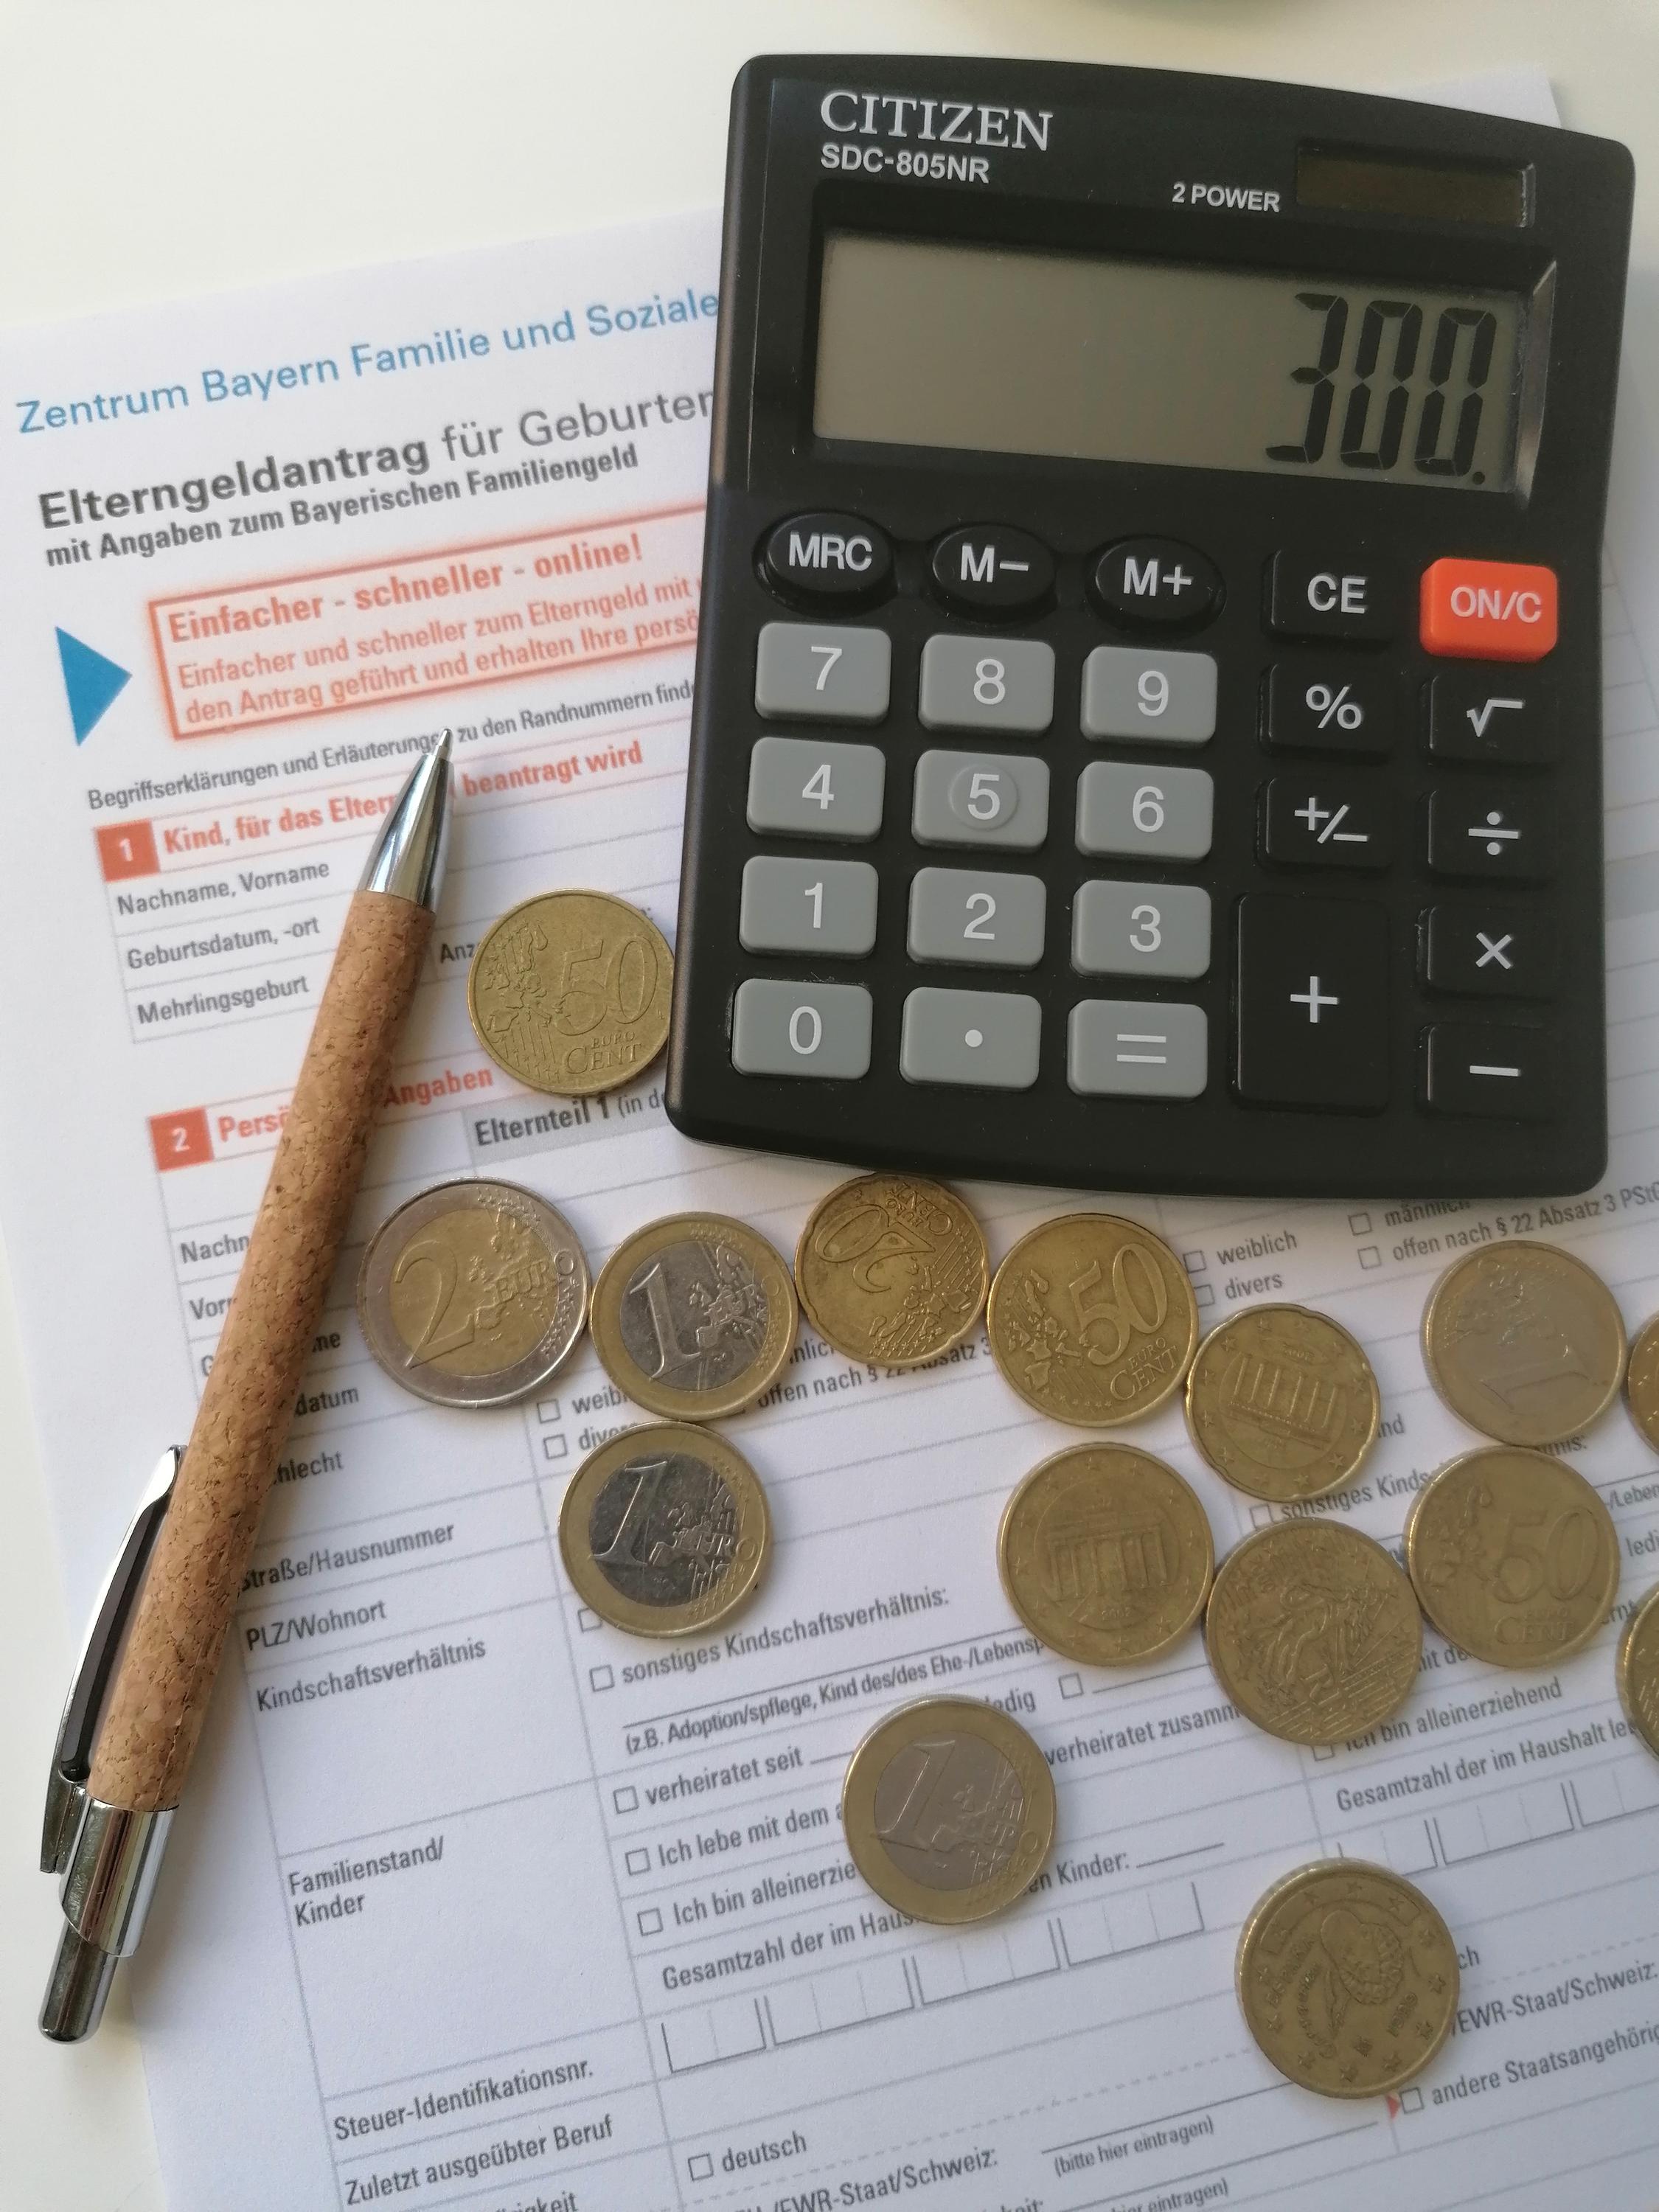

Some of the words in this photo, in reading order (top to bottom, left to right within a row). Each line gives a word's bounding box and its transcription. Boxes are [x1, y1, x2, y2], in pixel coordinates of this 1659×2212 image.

[820, 89, 1053, 152] CITIZEN
[821, 145, 990, 184] SDC-805NR
[1172, 184, 1186, 203] 2
[1190, 184, 1281, 213] POWER
[15, 384, 189, 434] Zentrum
[202, 358, 339, 402] Bayern
[350, 328, 490, 376] Familie
[504, 310, 576, 351] und
[38, 440, 430, 529] Elterngeldantrag
[442, 422, 503, 461] für
[46, 538, 92, 566] mit
[100, 521, 222, 558] Angaben
[230, 508, 284, 537] zum
[291, 478, 461, 527] Bayerischen
[467, 443, 639, 495] Familiengeld
[788, 534, 873, 571] MRC
[1124, 558, 1192, 597] M+
[168, 597, 323, 643] Einfacher
[354, 563, 503, 611] schneller
[535, 533, 643, 579] online!
[1307, 576, 1366, 614] CE
[1450, 586, 1543, 624] ON/C
[178, 652, 295, 689] Einfacher
[305, 639, 349, 667] und
[357, 621, 467, 658] schneller
[476, 613, 524, 638] zum
[528, 582, 648, 627] Elterngeld
[653, 576, 688, 603] mit
[186, 700, 232, 724] den
[239, 684, 323, 714] Antrag
[330, 664, 418, 703] geführt
[425, 653, 468, 681] und
[476, 639, 574, 672] erhalten
[581, 627, 628, 653] Ihre
[810, 647, 843, 692] 7
[973, 658, 1006, 704] 8
[1136, 671, 1169, 716] 9
[88, 763, 279, 810] Begriffserklärungen
[283, 757, 319, 776] und
[324, 731, 445, 767] Erläuterunge
[458, 726, 479, 742] zu
[482, 717, 517, 736] den
[521, 692, 653, 731] Randnummern
[120, 840, 133, 861] 1
[164, 823, 231, 855] Kind,
[236, 816, 271, 840] für
[279, 806, 324, 832] das
[462, 756, 581, 798] beantragt
[585, 740, 643, 773] wird
[802, 765, 835, 810] 4
[968, 774, 1000, 819] 5
[1133, 787, 1165, 832] 6
[116, 877, 236, 917] Nachname,
[239, 863, 330, 891] Vorname
[804, 884, 821, 929] 1
[964, 894, 997, 940] 2
[1129, 907, 1162, 953] 3
[128, 928, 279, 970] Geburtsdatum,
[283, 917, 320, 940] -ort
[441, 942, 473, 964] Anz
[136, 975, 310, 1028] Mehrlingsgeburt
[554, 935, 658, 1036] 50
[591, 1032, 636, 1050] EURO
[789, 1007, 822, 1054] 0
[567, 1043, 641, 1074] CENT
[172, 1128, 190, 1152] 2
[474, 1094, 591, 1146] Elternteil
[597, 1096, 610, 1119] 1
[617, 1095, 636, 1119] (in
[180, 1234, 249, 1264] Nachn
[1217, 1231, 1298, 1267] weiblich
[1393, 1235, 1440, 1261] offen
[1445, 1222, 1492, 1248] nach
[1497, 1217, 1508, 1237] §
[1512, 1213, 1534, 1234] 22
[1539, 1200, 1601, 1229] Absatz
[1604, 1194, 1616, 1213] 3
[394, 1239, 476, 1369] 2
[1069, 1242, 1167, 1366] 50
[1225, 1270, 1283, 1301] divers
[629, 1262, 702, 1381] 1
[1110, 1345, 1179, 1400] CENT
[1128, 1338, 1166, 1369] EURO
[295, 1387, 359, 1416] datum
[813, 1366, 862, 1397] nach
[276, 1451, 344, 1484] hlecht
[588, 1461, 667, 1566] 1
[1491, 1506, 1599, 1603] 50
[246, 1599, 386, 1651] PLZ/Wohnort
[622, 1643, 720, 1685] sonstiges
[724, 1585, 950, 1658] Kindschaftsverhältnis:
[257, 1637, 485, 1711] Kindschaftsverhältnis
[625, 1730, 663, 1755] (z.B.
[668, 1694, 816, 1742] Adoption/spflege,
[818, 1677, 858, 1705] Kind
[860, 1665, 929, 1694] des/des
[1380, 1718, 1411, 1745] bin
[1416, 1677, 1562, 1733] alleinerziehend
[1043, 1721, 1155, 1768] verheiratet
[1336, 1761, 1453, 1812] Gesamtzahl
[1455, 1756, 1487, 1781] der
[1492, 1747, 1517, 1771] im
[1519, 1722, 1613, 1764] Haushalt
[644, 1753, 759, 1806] verheiratet
[764, 1747, 804, 1775] seit
[658, 1843, 693, 1867] Ich
[697, 1829, 742, 1854] lebe
[747, 1817, 781, 1844] mit
[785, 1807, 830, 1835] dem
[288, 1834, 445, 1896] Familienstand/
[1056, 1854, 1130, 1885] Kinder:
[294, 1893, 365, 1927] Kinder
[674, 1899, 711, 1927] Ich
[713, 1887, 748, 1915] bin
[752, 1863, 856, 1906] alleinerzie
[663, 1943, 786, 1992] Gesamtzahl
[790, 1925, 827, 1955] der
[830, 1918, 856, 1946] im
[334, 2059, 594, 2141] Steuer-Identifikationsnr.
[1432, 2074, 1500, 2105] andere
[344, 2167, 422, 2207] Zuletzt
[425, 2135, 547, 2185] ausgeübter
[552, 2113, 613, 2150] Beruf
[723, 2130, 807, 2173] deutsch
[1054, 2153, 1095, 2177] (bitte
[1097, 2141, 1128, 2163] hier
[1134, 2115, 1214, 2154] eintragen)
[1148, 2177, 1228, 2212] eintragen)
